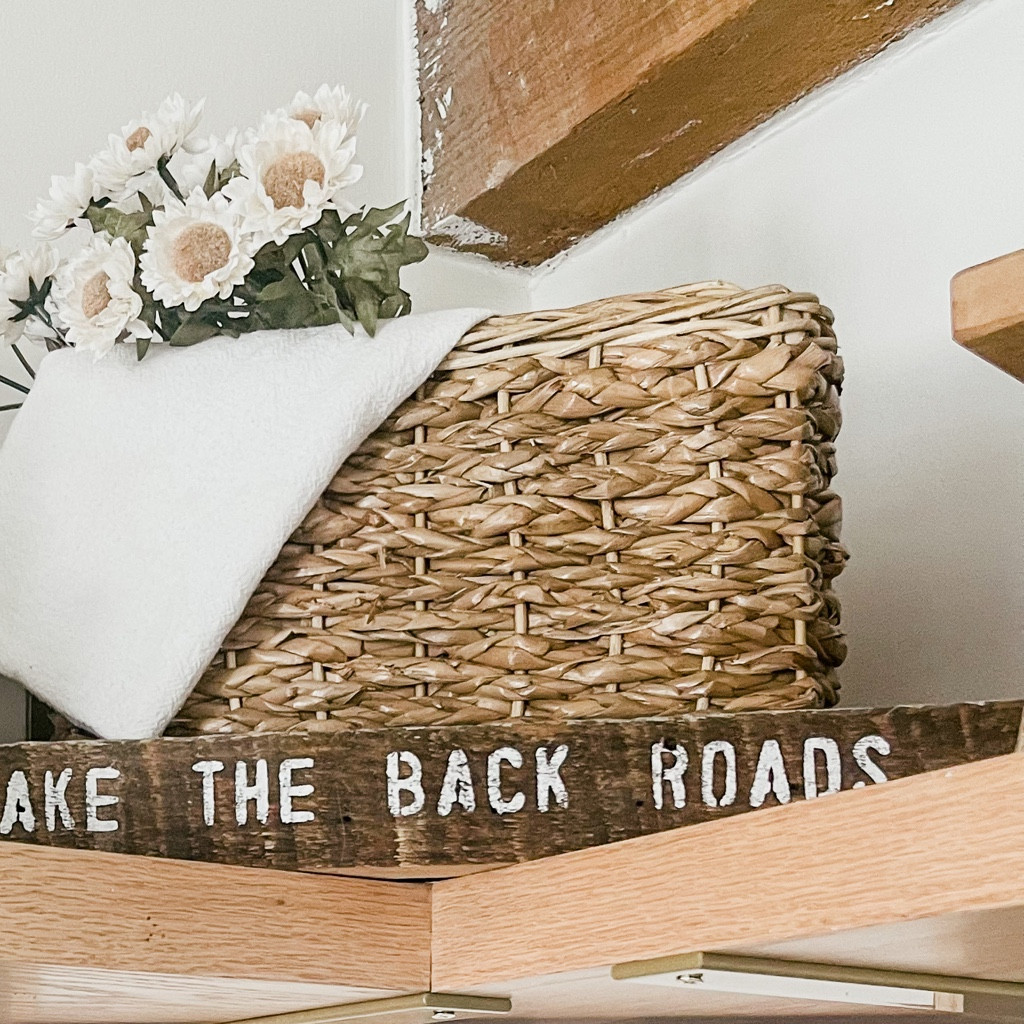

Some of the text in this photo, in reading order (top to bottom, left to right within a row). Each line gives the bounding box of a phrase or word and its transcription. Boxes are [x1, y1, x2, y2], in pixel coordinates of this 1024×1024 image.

[191, 757, 315, 826] THE
[386, 744, 570, 818] BACK
[651, 735, 891, 809] ROADS
